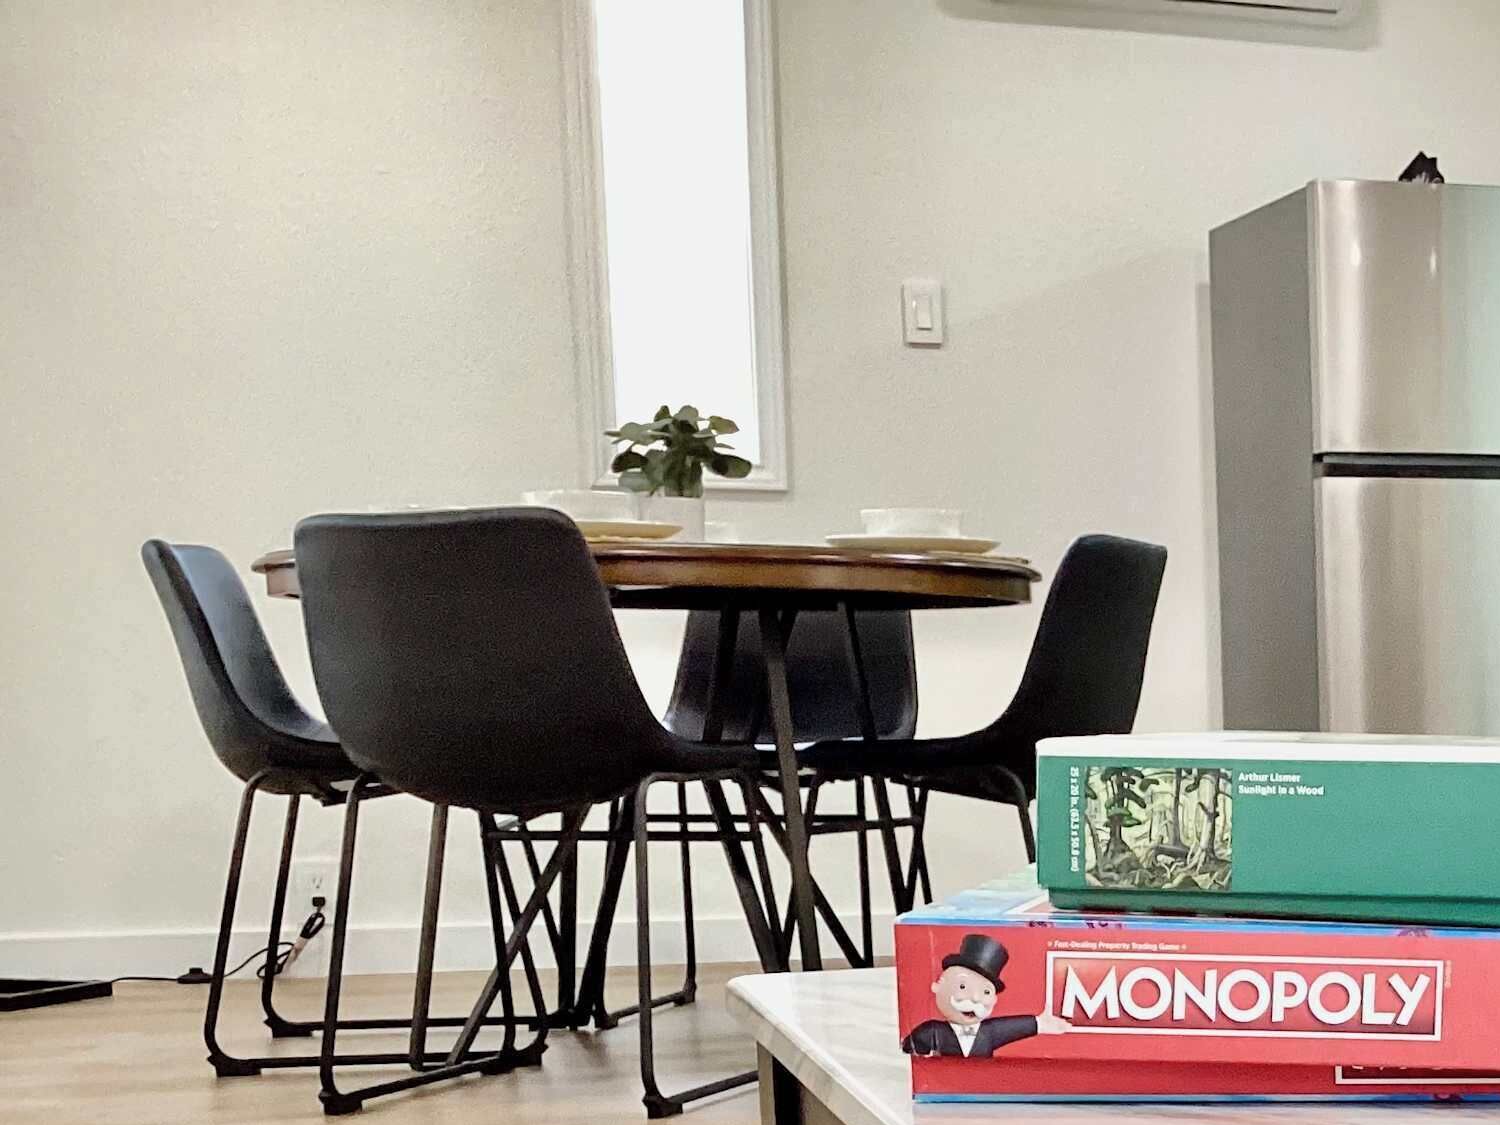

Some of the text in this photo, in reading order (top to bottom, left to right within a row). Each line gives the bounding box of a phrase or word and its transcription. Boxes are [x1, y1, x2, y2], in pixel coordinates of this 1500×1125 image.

[1238, 772, 1301, 783] Arthur Lismer
[1070, 785, 1080, 795] 20
[1238, 785, 1325, 796] Sunlight in a Wood
[1053, 940, 1180, 952] Fast-Dealing Property Trading Game
[1060, 964, 1431, 1027] MONOPOLY
